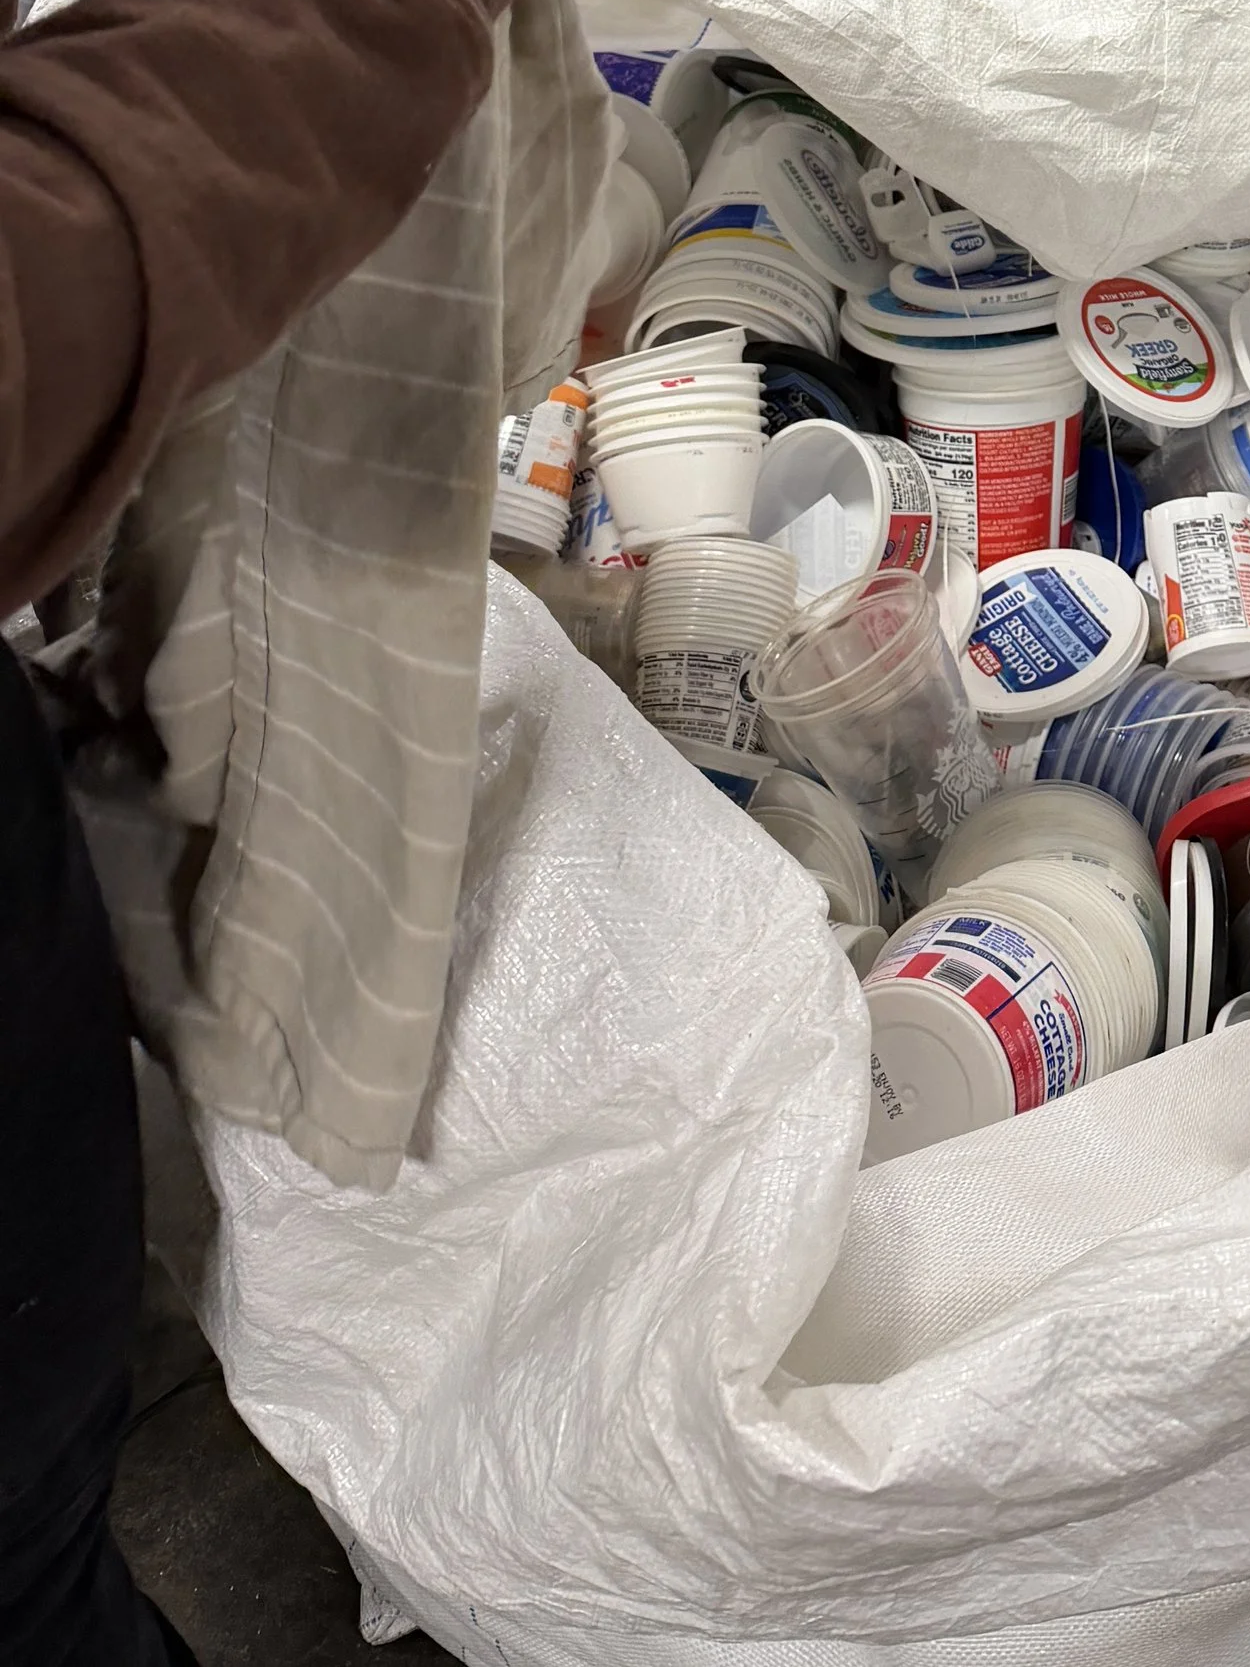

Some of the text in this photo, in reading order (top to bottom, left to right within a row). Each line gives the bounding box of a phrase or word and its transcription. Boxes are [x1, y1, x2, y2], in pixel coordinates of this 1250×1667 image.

[954, 236, 982, 250] Glide
[1121, 290, 1147, 299] WHOLE
[1125, 339, 1178, 358] GREEK
[1141, 354, 1179, 366] ORGANIC
[1140, 360, 1195, 381] Stonyfield
[943, 433, 974, 444] Facts
[952, 469, 974, 480] 120
[1176, 519, 1206, 530] Nutrition
[904, 531, 922, 570] Heluva
[917, 519, 931, 558] Good!
[1177, 539, 1208, 551] Calories
[979, 590, 1027, 625] ORIGIN
[1031, 572, 1078, 621] Pasteurized
[1004, 615, 1059, 673] CHEESE
[1079, 622, 1105, 645] GRADE
[973, 648, 994, 675] GIANT
[979, 644, 1002, 671] EAGLE
[988, 627, 1037, 685] Cottage
[1067, 642, 1090, 664] 4%
[971, 947, 1007, 969] PASTEURIZED
[1000, 1024, 1010, 1040] NET
[1007, 1041, 1018, 1055] WT
[1016, 1070, 1025, 1084] OZ
[1022, 1020, 1041, 1070] 4% MILKFAT
[1039, 999, 1066, 1098] COTTAGE
[1059, 1013, 1074, 1073] Small Curd
[1033, 1014, 1056, 1100] CHEESE
[880, 1072, 904, 1116] ENJOY BY
